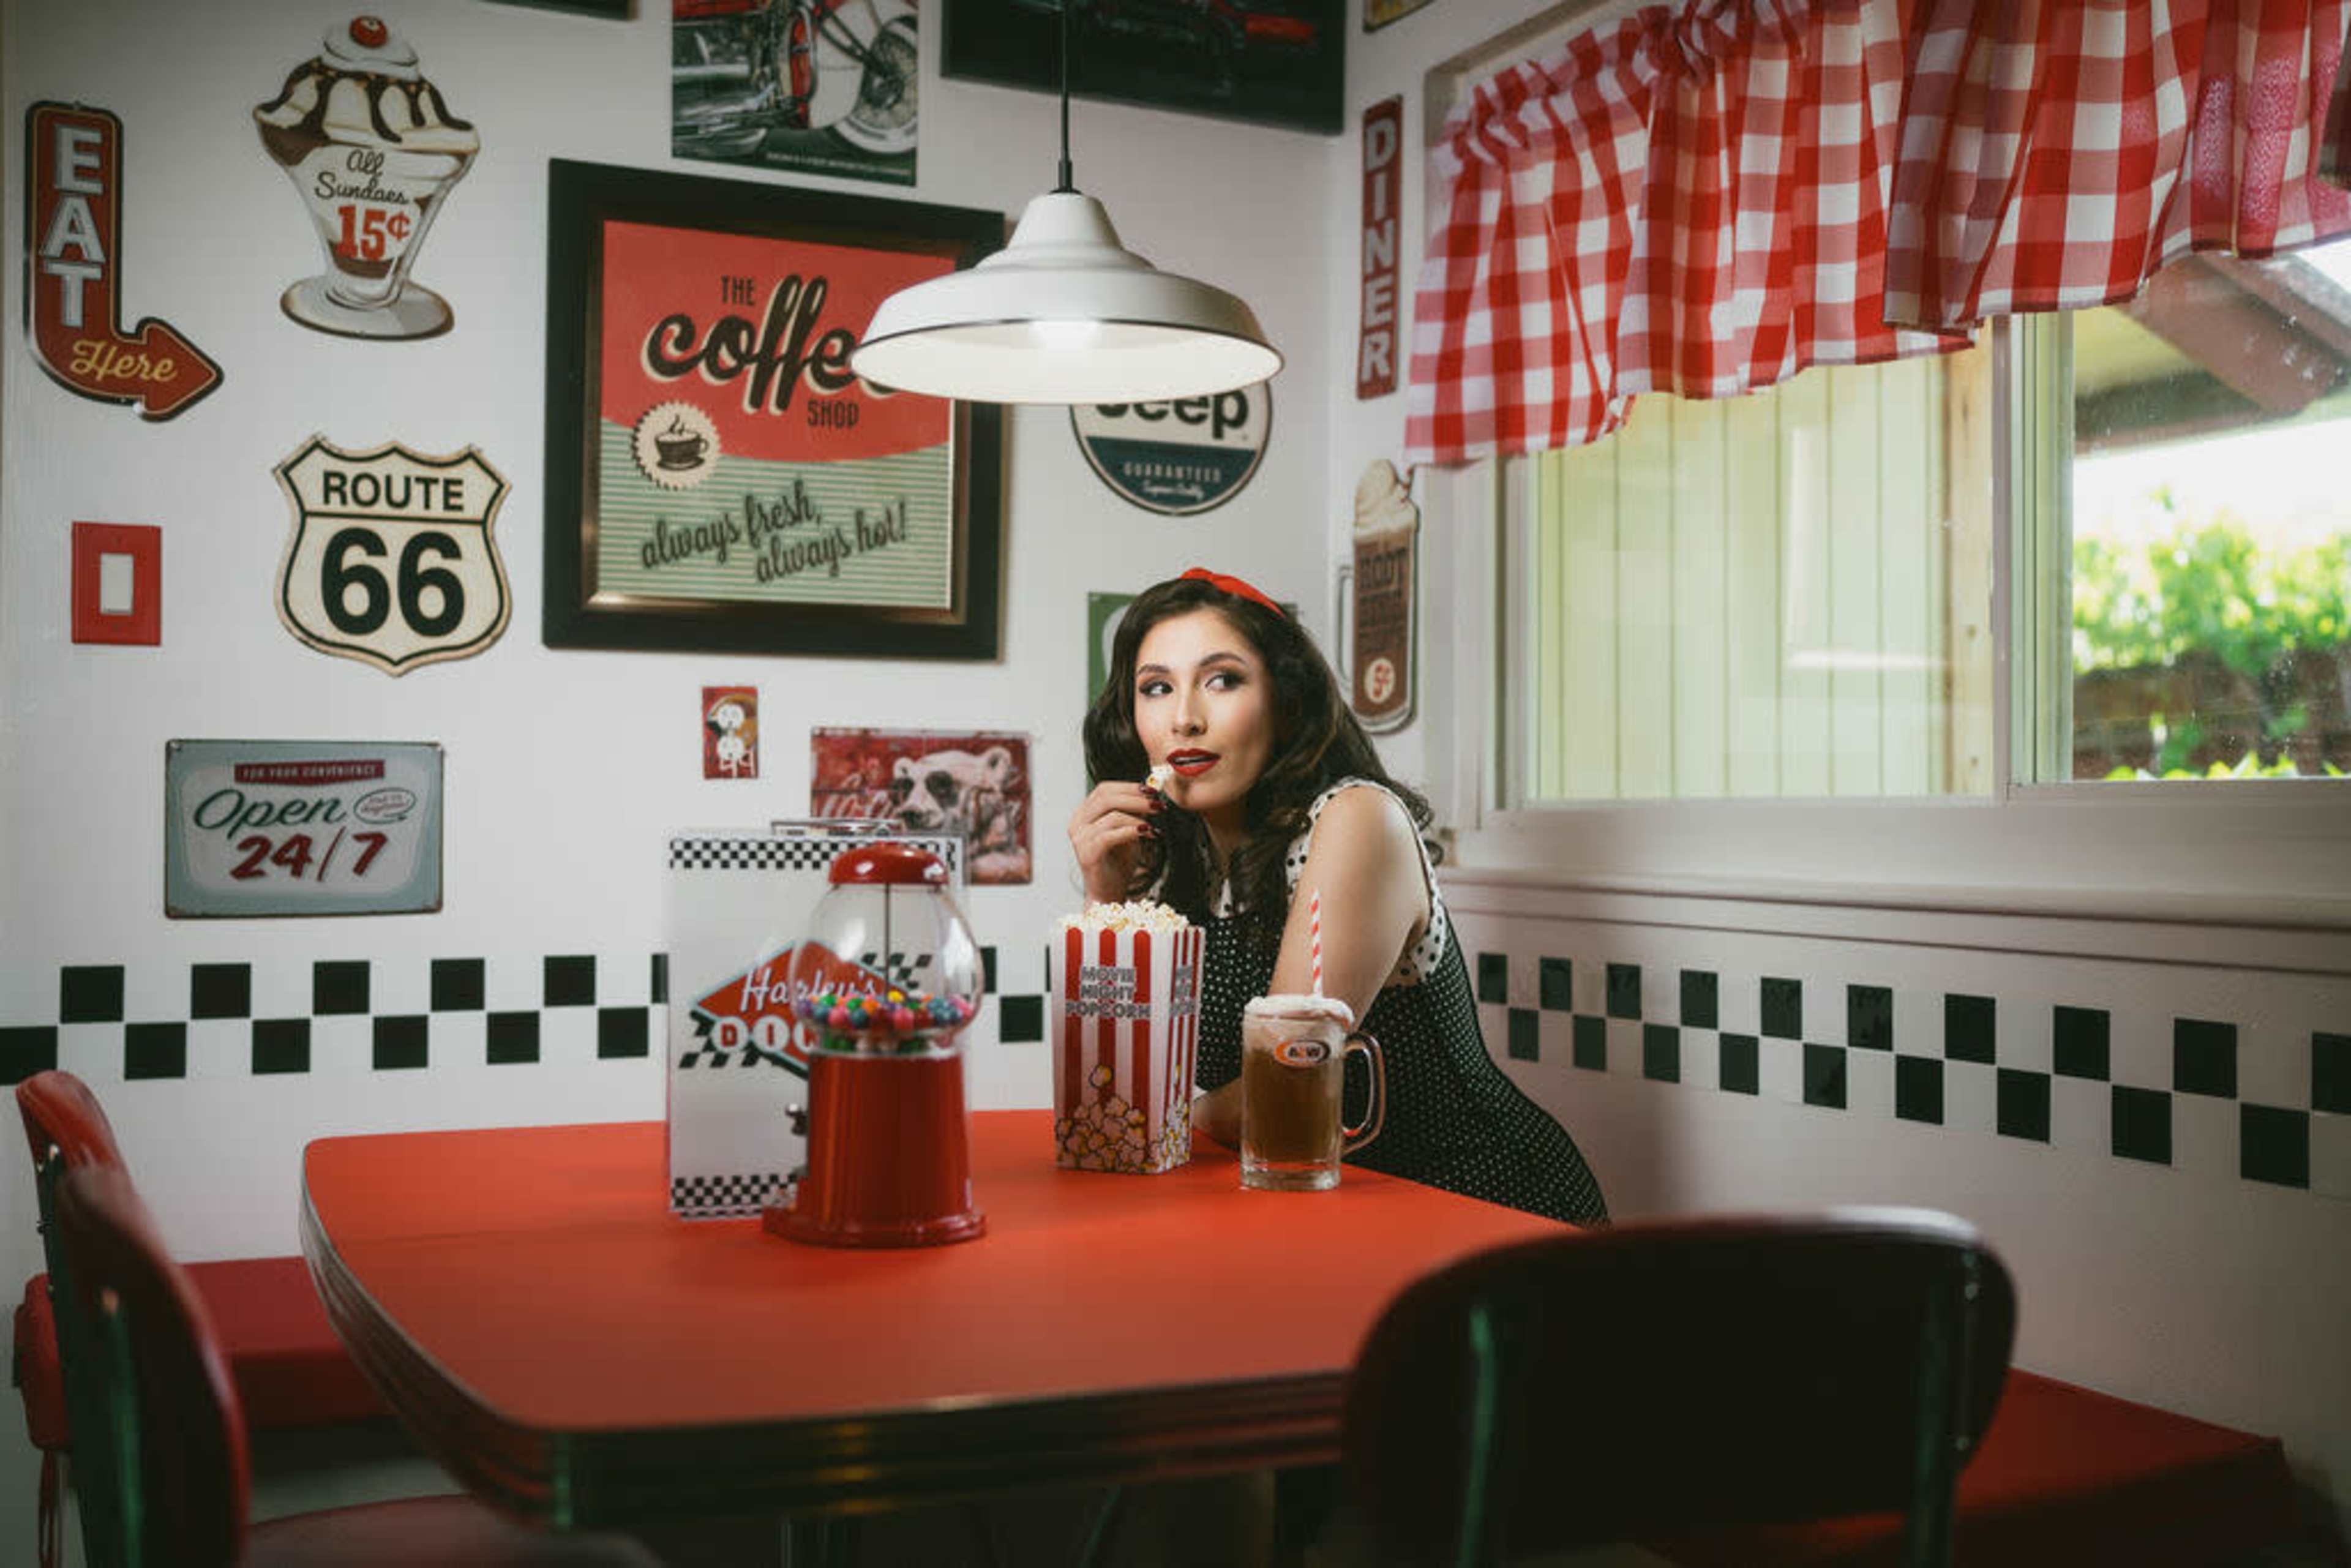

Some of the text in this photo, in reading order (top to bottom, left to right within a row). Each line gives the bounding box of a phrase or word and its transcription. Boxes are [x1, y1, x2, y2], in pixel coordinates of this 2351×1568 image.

[346, 149, 384, 176] All
[314, 171, 410, 204] Sundaes
[39, 124, 107, 329] EAT
[334, 204, 411, 262] 15¢
[1361, 118, 1397, 382] DINER
[721, 276, 755, 306] THE
[70, 340, 178, 382] Here
[640, 274, 895, 415] coffe
[807, 401, 860, 429] SHOP
[323, 470, 465, 512] ROUTE
[1123, 461, 1222, 483] GUARANTEED
[642, 479, 822, 568] always fresh,
[756, 501, 907, 583] always hot!
[321, 527, 465, 637] 66
[193, 789, 347, 840] Open
[229, 826, 389, 882] 24/7
[1081, 966, 1136, 982] MOVIE
[1081, 984, 1134, 999] NIGHT
[1065, 1000, 1152, 1019] POPCORN
[1288, 1045, 1321, 1060] A&W
